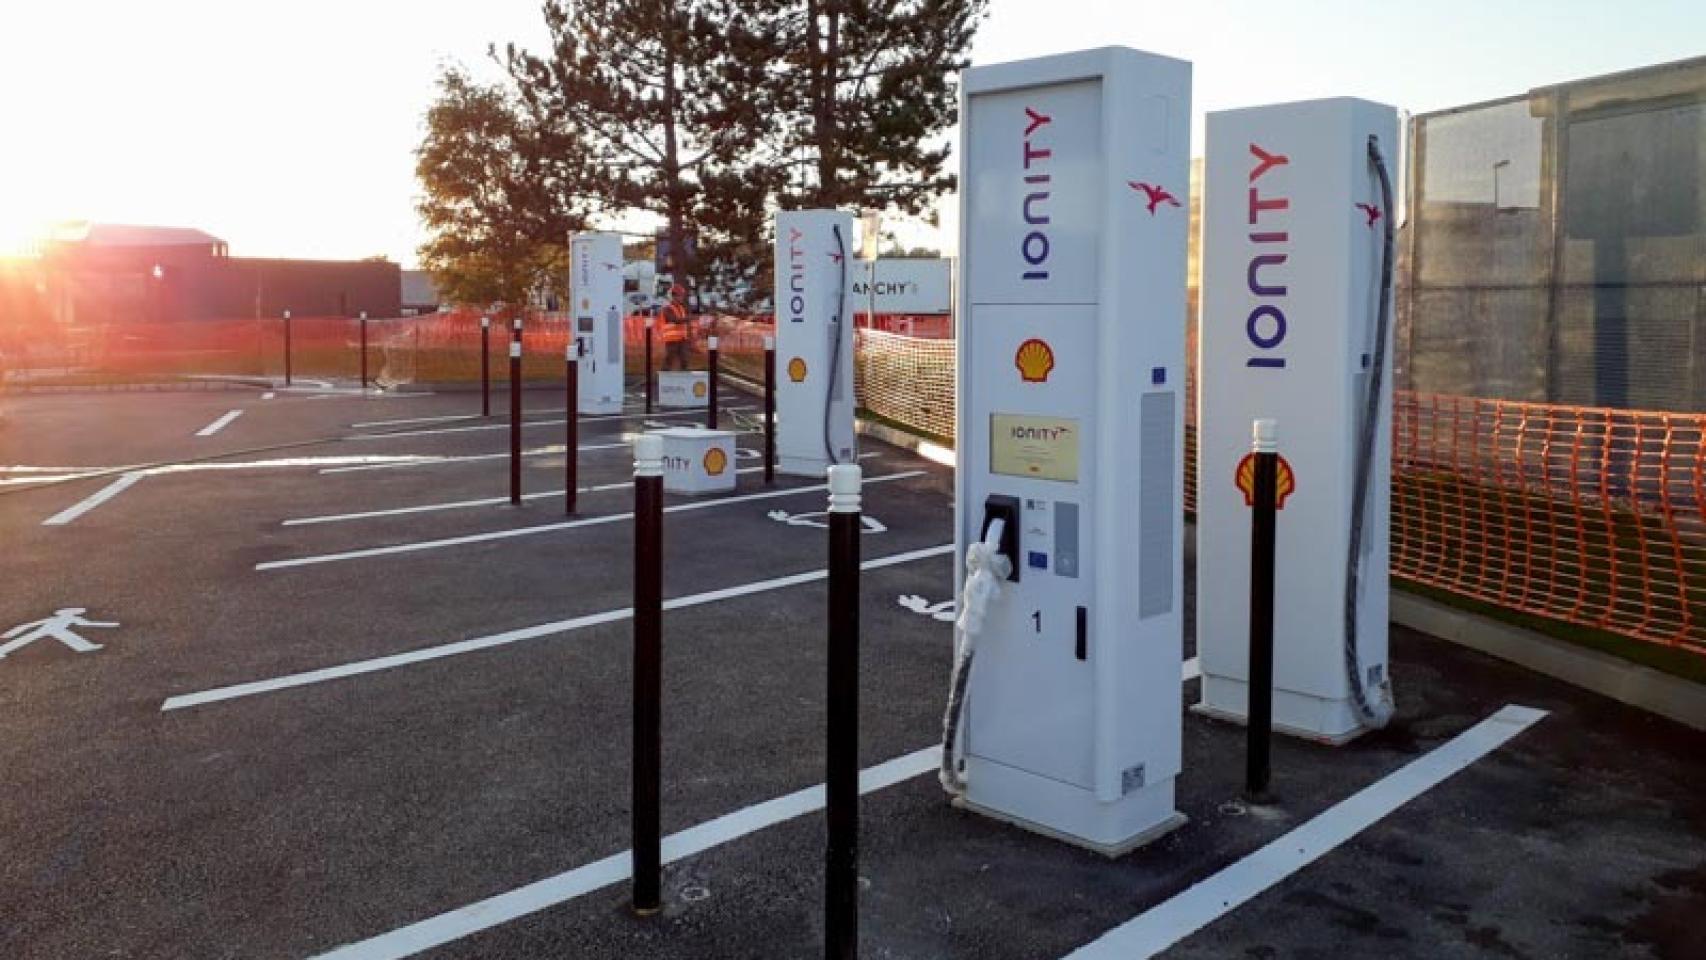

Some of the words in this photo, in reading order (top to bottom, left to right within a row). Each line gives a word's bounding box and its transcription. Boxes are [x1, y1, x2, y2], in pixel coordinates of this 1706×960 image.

[1022, 106, 1051, 280] IONITY
[790, 227, 804, 323] IONITY
[1246, 142, 1290, 369] IONITY
[1010, 425, 1059, 441] IONITY
[662, 455, 691, 472] NITY
[1031, 609, 1041, 633] 1
